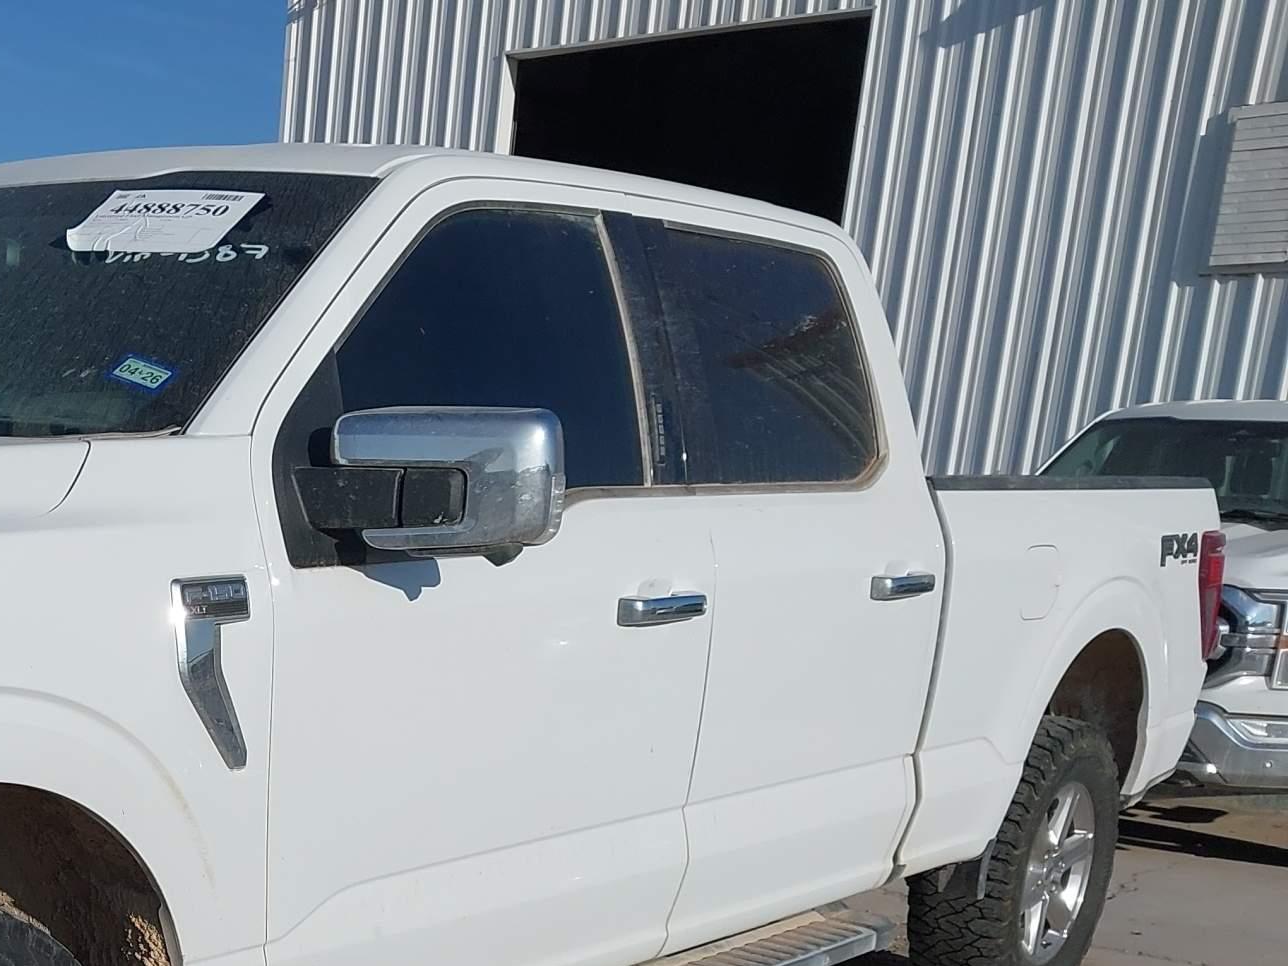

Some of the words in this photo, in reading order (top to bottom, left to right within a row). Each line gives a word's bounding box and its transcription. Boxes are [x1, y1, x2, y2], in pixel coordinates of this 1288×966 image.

[111, 203, 229, 216] 44888750
[1160, 532, 1198, 567] FX4
[191, 605, 208, 615] XLT
